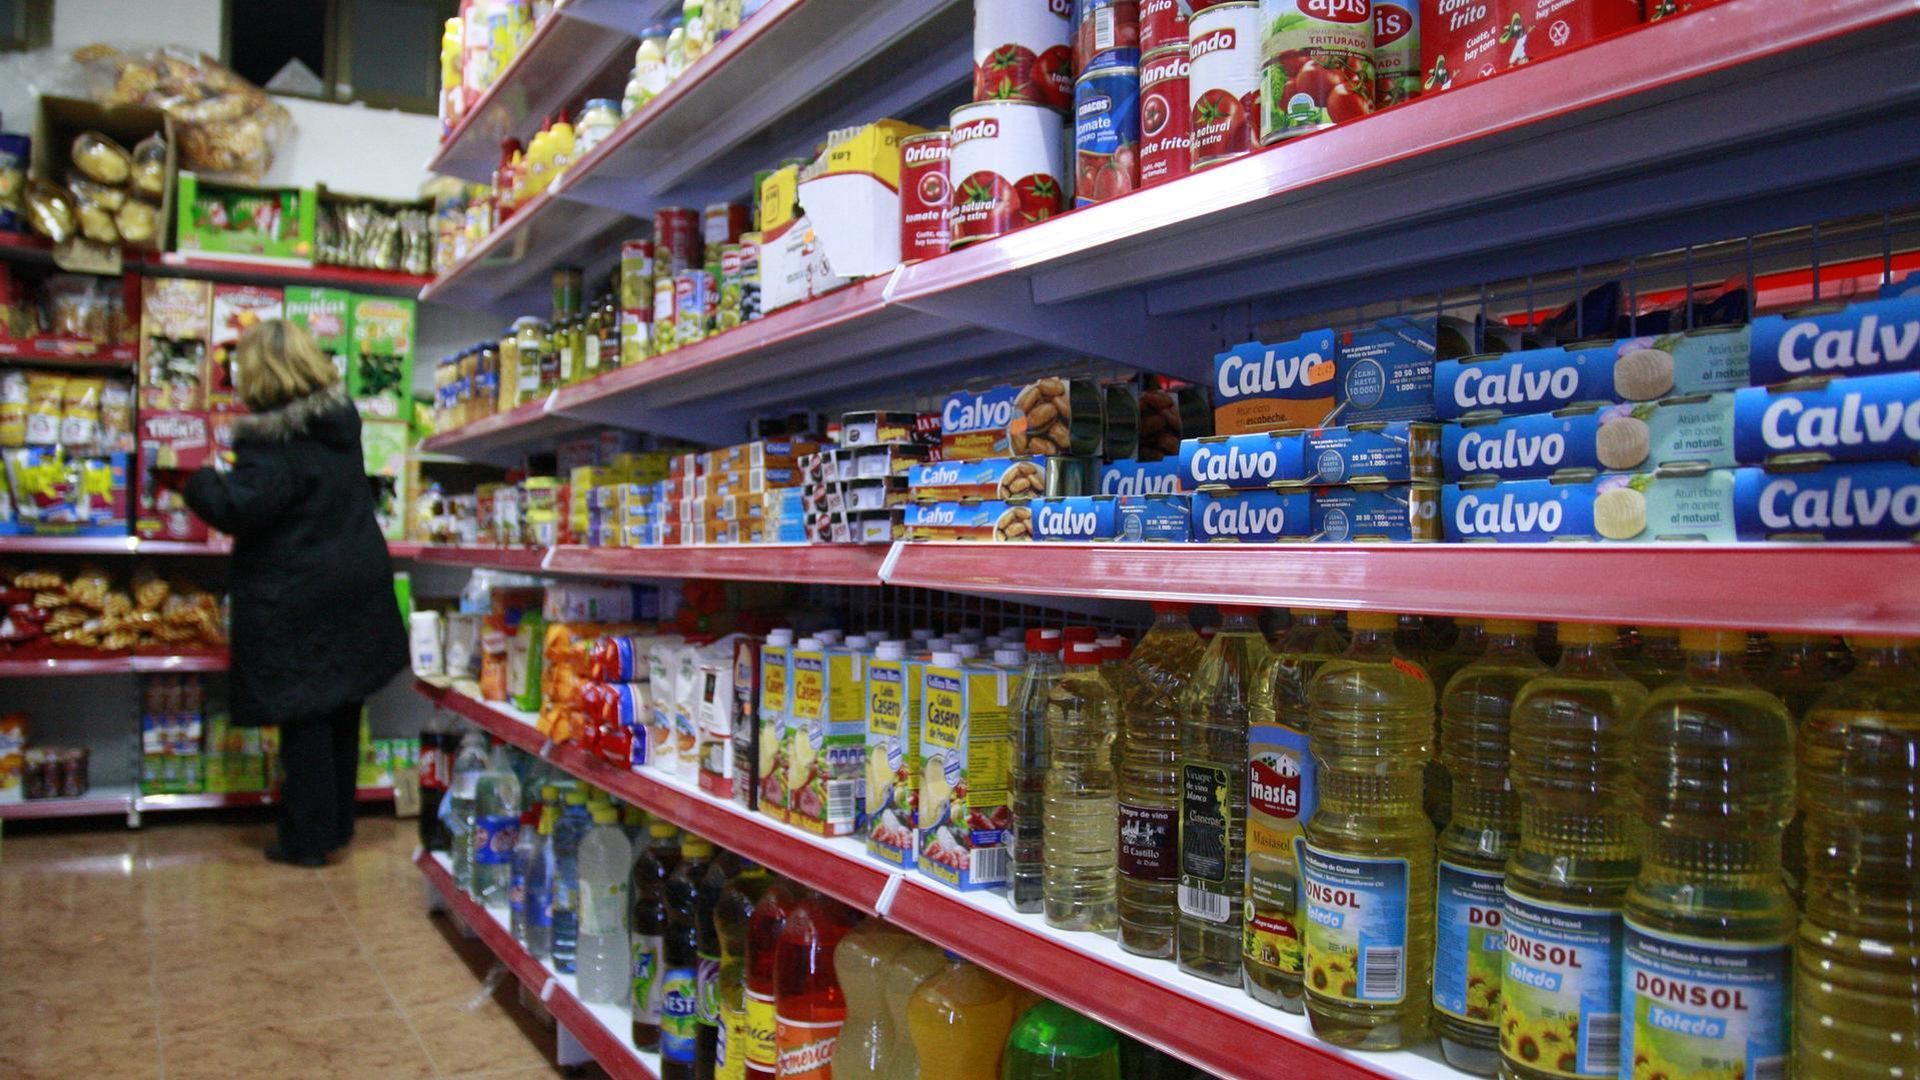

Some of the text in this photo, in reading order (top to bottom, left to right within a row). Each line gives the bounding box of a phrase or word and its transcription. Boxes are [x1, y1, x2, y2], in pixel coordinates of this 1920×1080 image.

[1377, 10, 1401, 36] is
[1450, 5, 1487, 32] frito
[1191, 31, 1233, 59] ando
[1309, 36, 1367, 49] TRITURADO
[1479, 38, 1496, 54] tom
[1376, 58, 1401, 69] ADO
[951, 120, 997, 146] lando
[1197, 119, 1232, 138] natural
[905, 143, 951, 163] Orlan
[1160, 136, 1191, 150] frito
[905, 211, 939, 223] tomate
[961, 198, 996, 213] natural
[1778, 315, 1920, 373] Calv
[1218, 350, 1323, 398] Calvo
[1453, 362, 1579, 408] Calvo
[943, 396, 1011, 431] Calvo
[1191, 446, 1277, 481] Calvo
[1457, 429, 1565, 472] Calvo
[922, 465, 959, 484] Calvo
[1102, 467, 1178, 496] Calvo
[918, 506, 954, 524] Calvo
[1456, 493, 1563, 534] Calvo
[1759, 477, 1920, 529] Calvo
[1038, 506, 1097, 536] Calvo
[1203, 500, 1285, 535] Calvo
[927, 702, 960, 730] Casero
[1251, 767, 1259, 782] la
[1251, 781, 1297, 807] masía
[1152, 811, 1169, 819] vino
[1306, 880, 1360, 909] ONSOL
[1469, 906, 1502, 927] DO
[1701, 954, 1712, 965] de
[1510, 961, 1556, 988] Toledo
[1636, 971, 1749, 1012] DONSOL
[1652, 1007, 1720, 1037] Toledo
